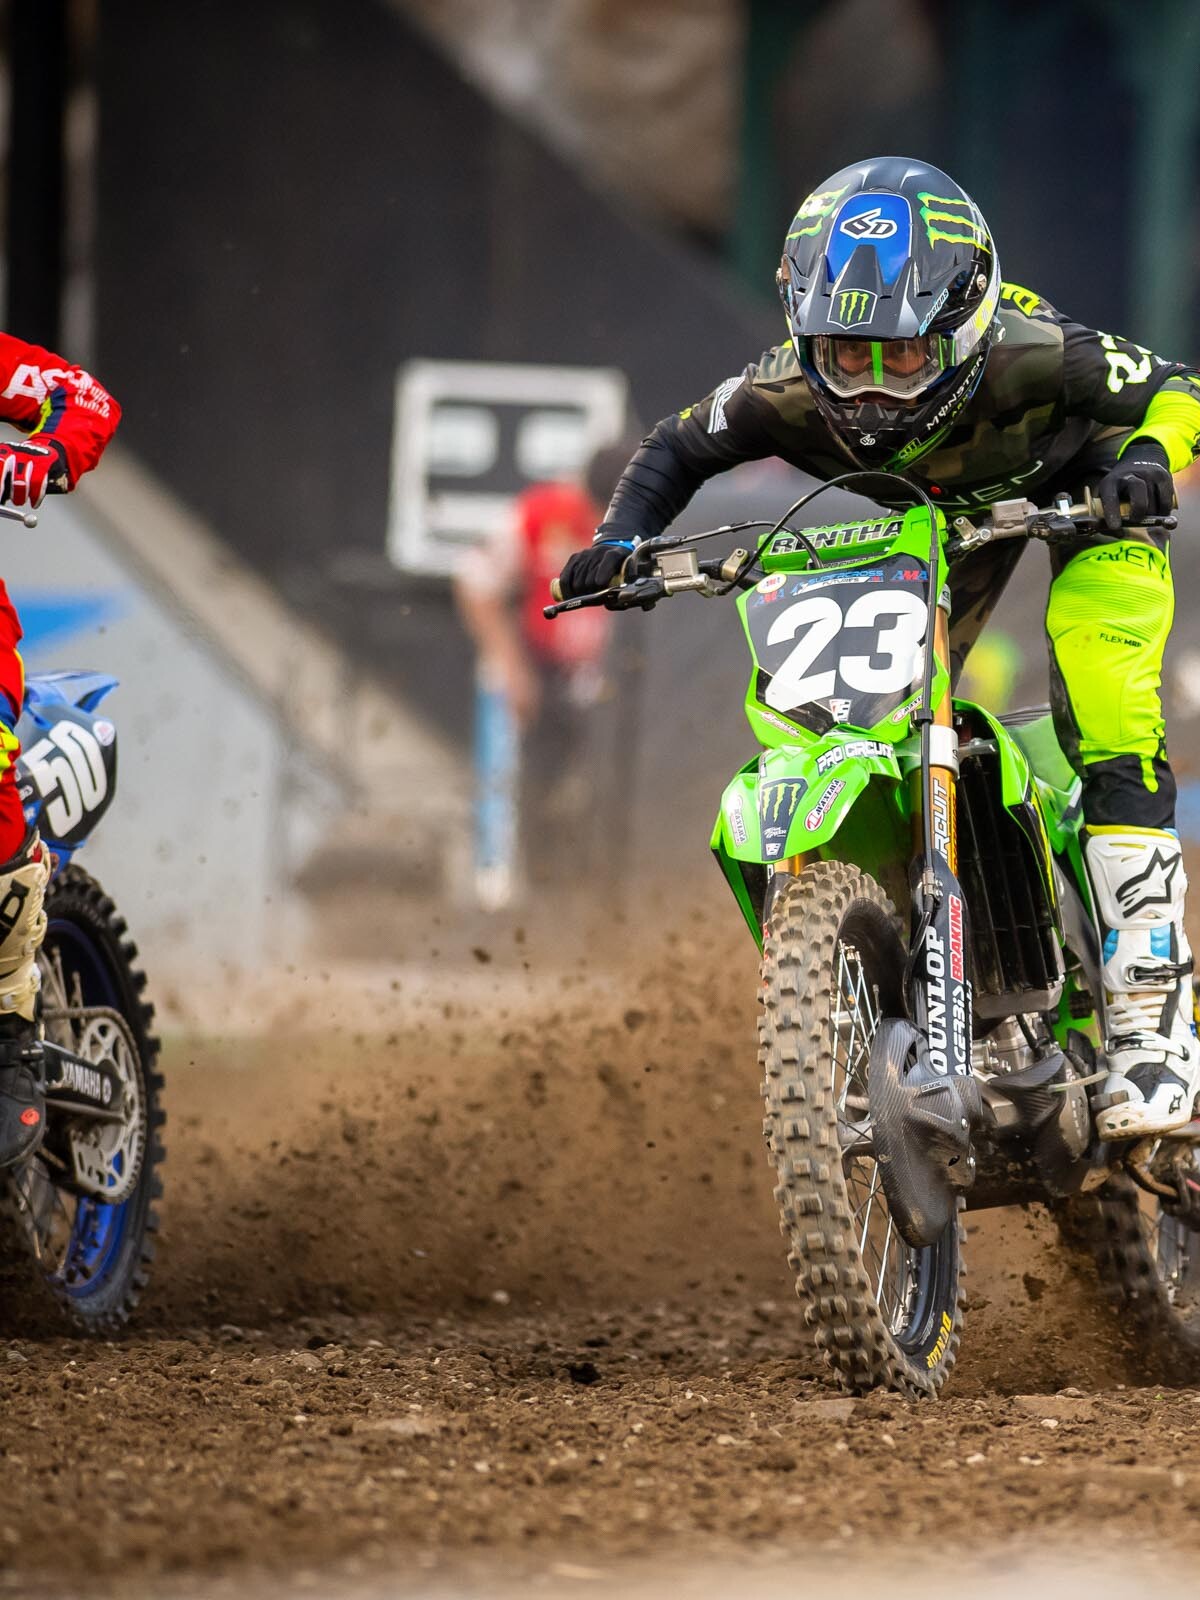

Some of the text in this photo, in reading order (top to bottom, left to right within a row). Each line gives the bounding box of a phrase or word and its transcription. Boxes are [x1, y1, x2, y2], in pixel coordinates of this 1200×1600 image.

[926, 354, 984, 431] MONSTER
[891, 569, 928, 582] AMA
[752, 588, 785, 608] AMA
[765, 590, 928, 712] 23
[1100, 633, 1122, 643] FLEX
[816, 740, 894, 776] PRO CIRCUIT
[22, 720, 107, 837] 50
[815, 779, 840, 816] MAXIMA
[950, 895, 964, 983] BRAKING
[926, 926, 948, 1074] DUNLOP
[61, 1060, 101, 1100] YAMAHA
